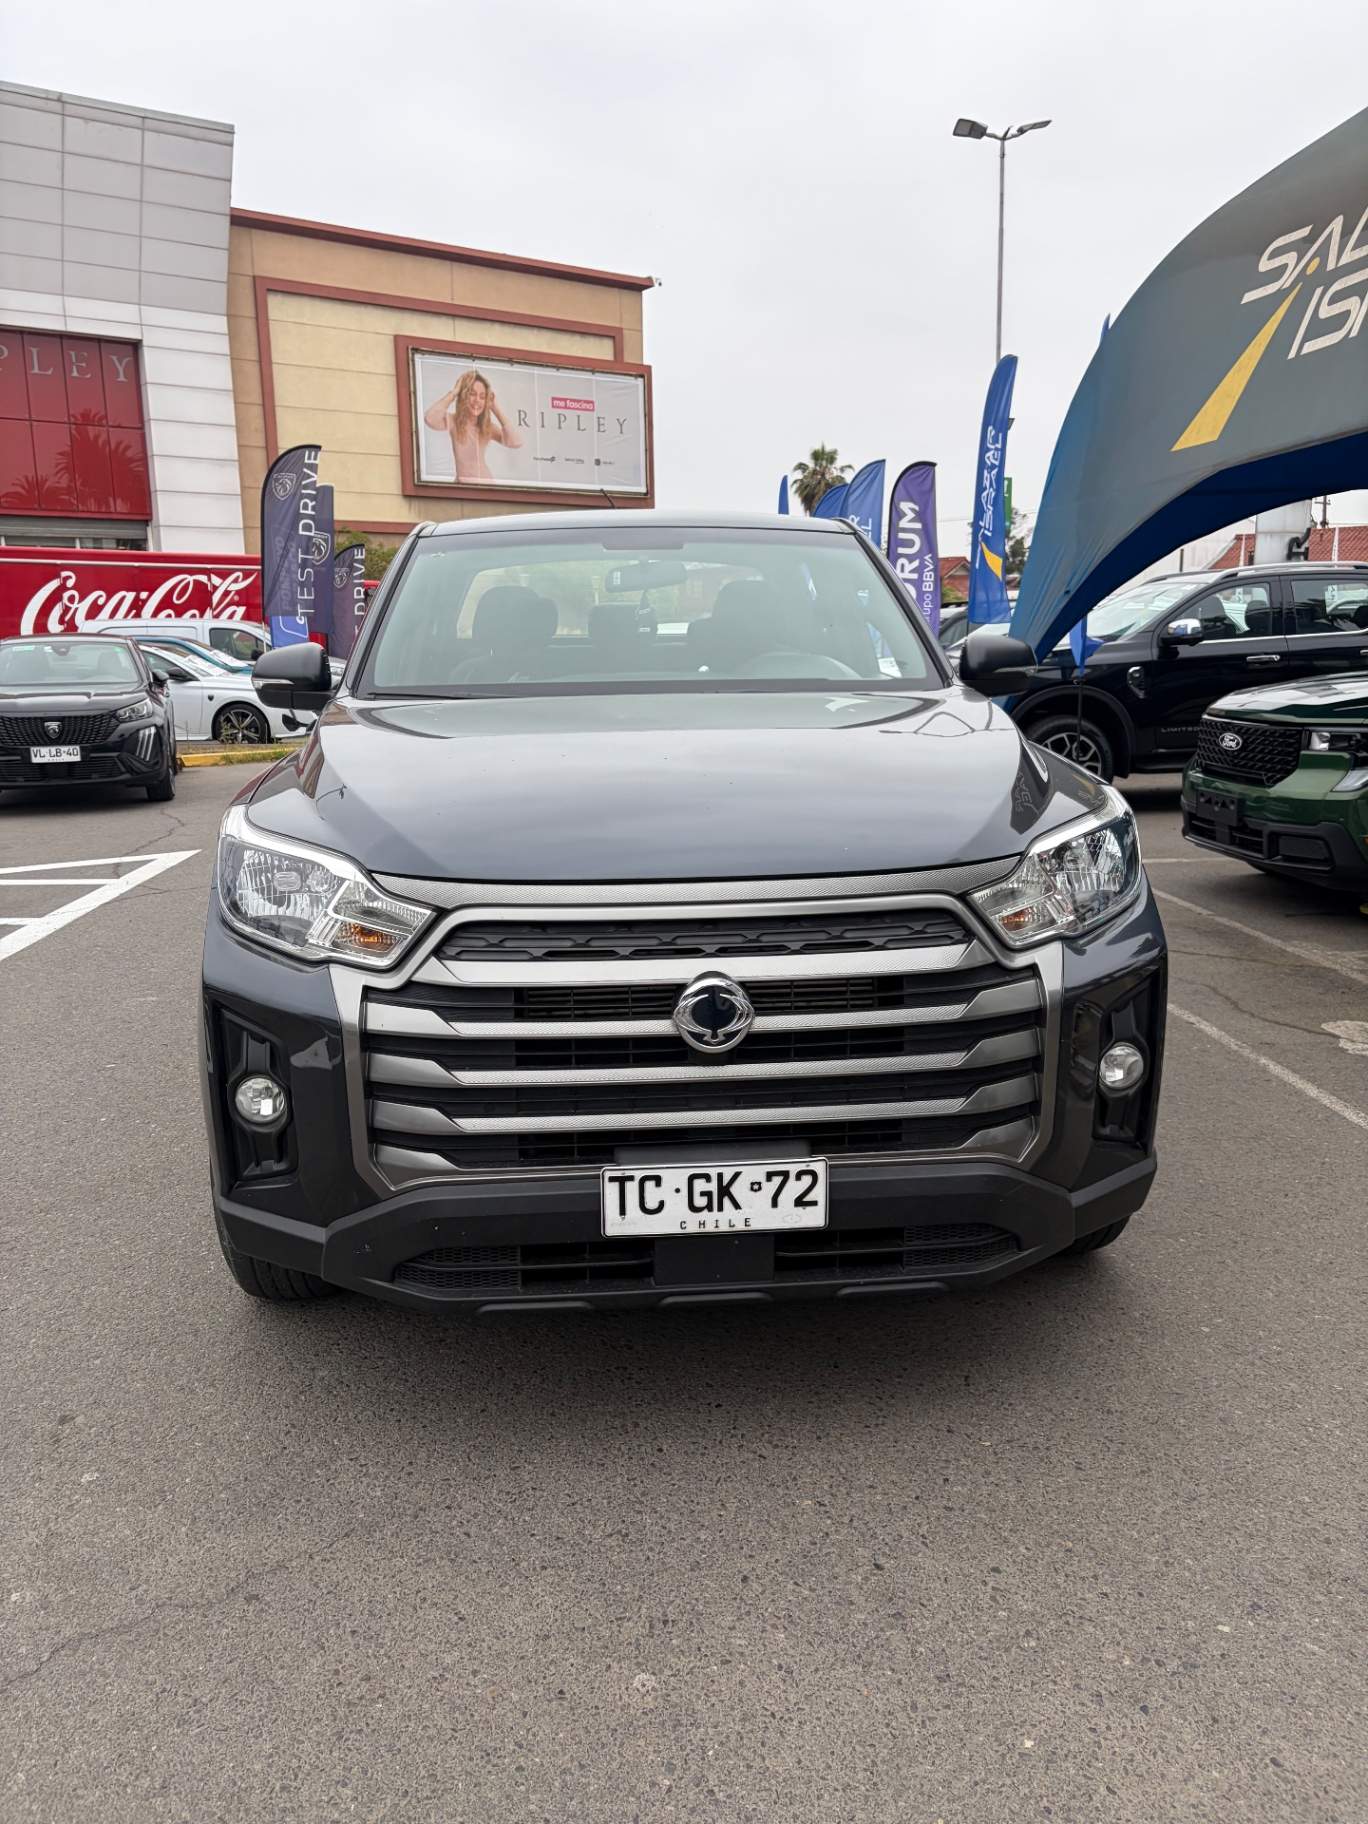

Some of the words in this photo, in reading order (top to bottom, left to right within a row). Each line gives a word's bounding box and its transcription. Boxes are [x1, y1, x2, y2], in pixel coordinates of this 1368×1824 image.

[517, 409, 627, 435] RIPLEY
[299, 450, 321, 536] DRIVE
[297, 548, 315, 613] TEST
[354, 548, 366, 615] DRIVE
[922, 553, 935, 591] BBVA
[680, 1217, 752, 1230] CHILE
